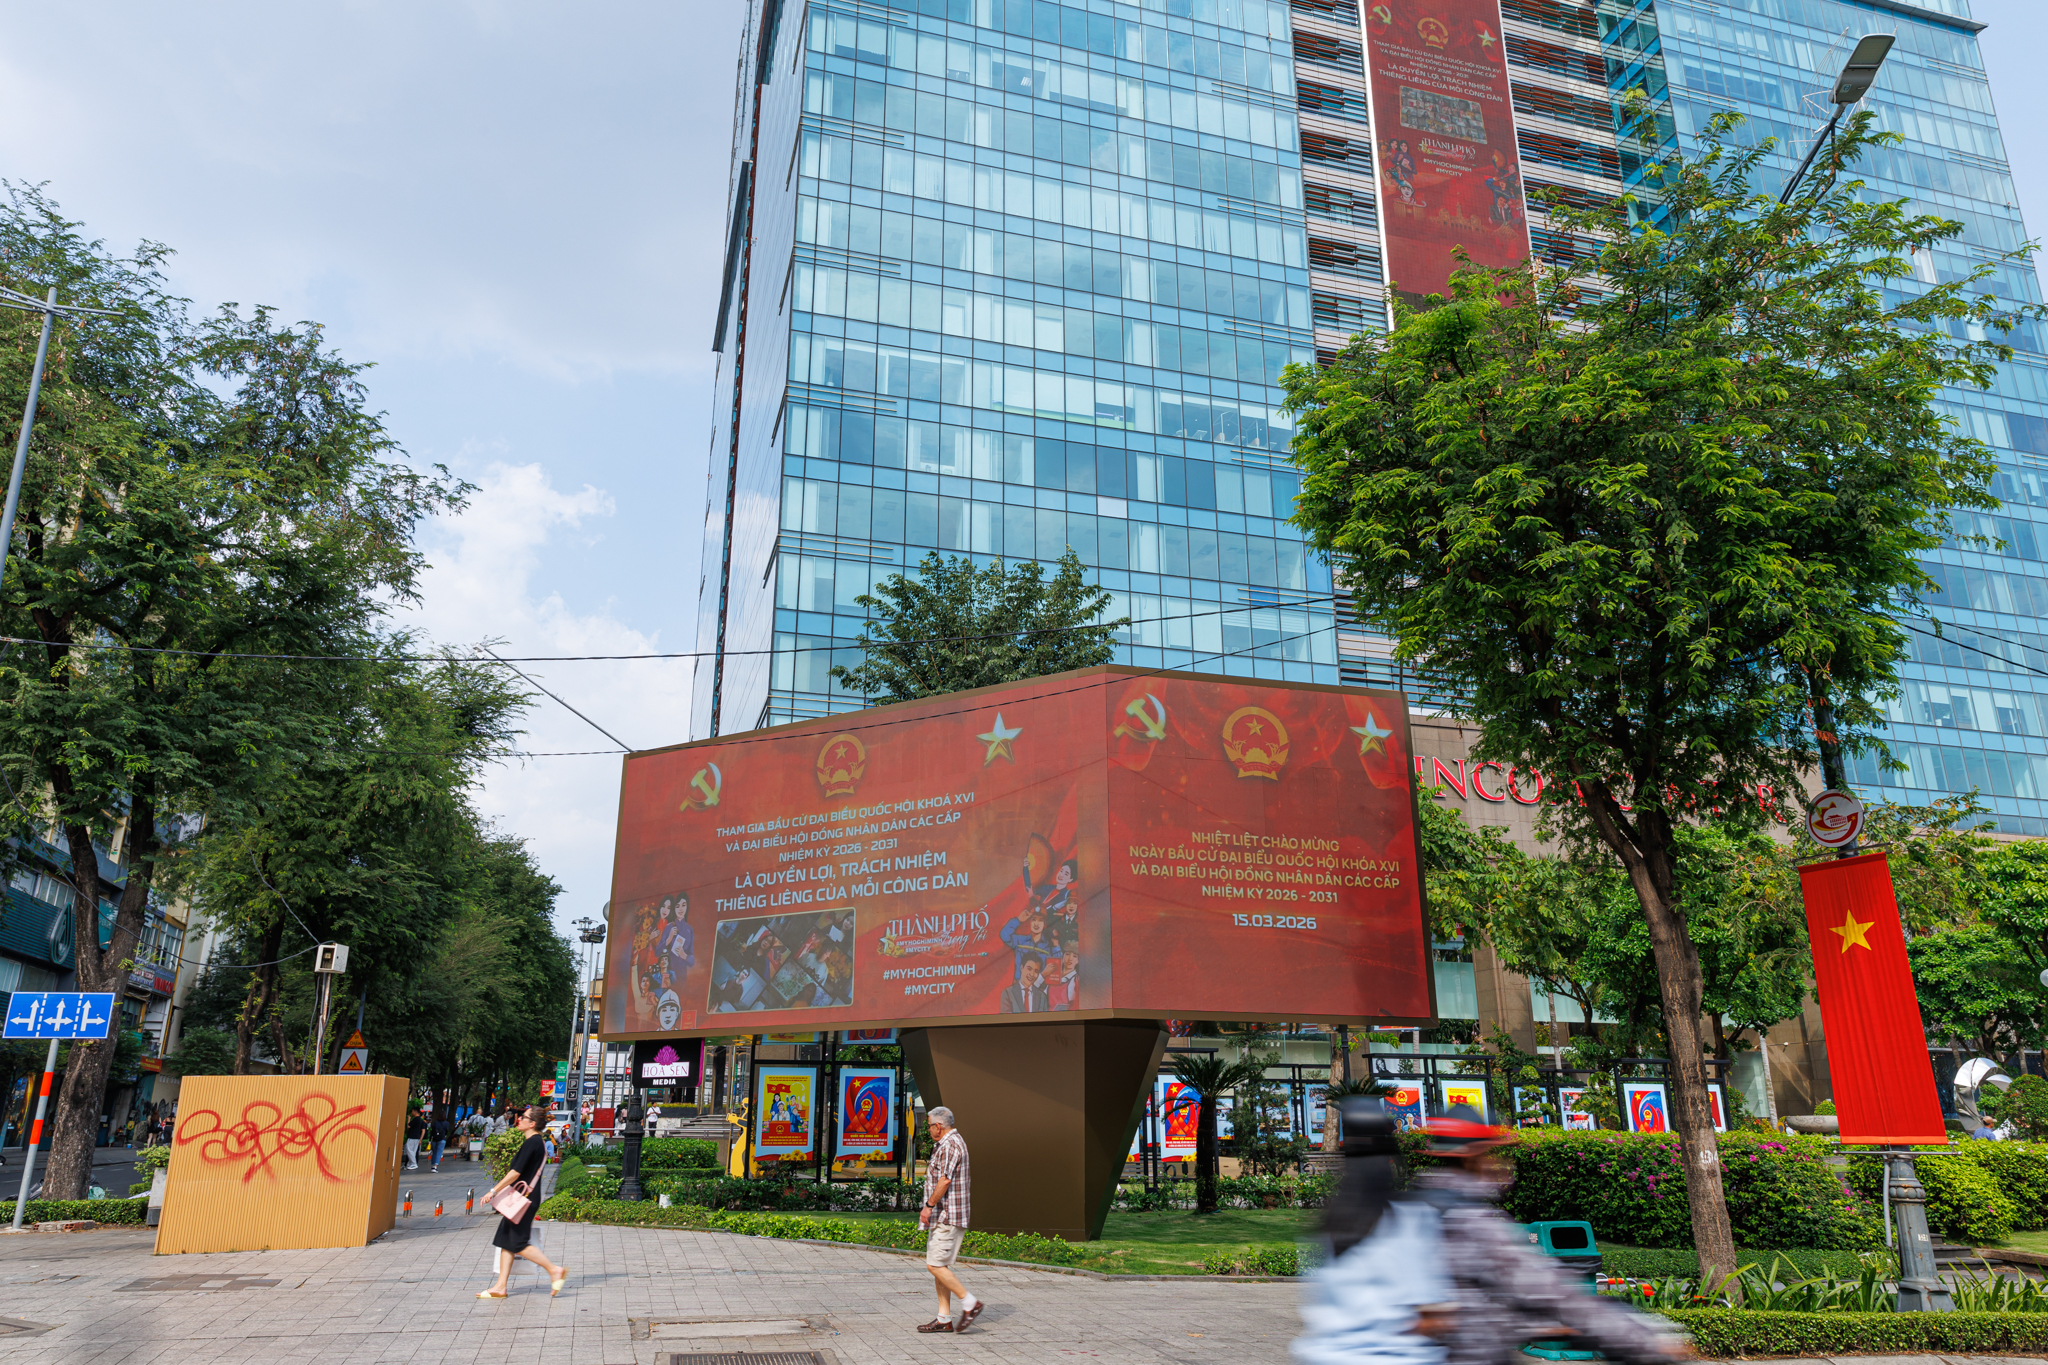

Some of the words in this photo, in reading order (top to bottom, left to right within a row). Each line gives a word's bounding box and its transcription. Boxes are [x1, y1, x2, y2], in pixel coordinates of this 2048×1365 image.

[716, 825, 745, 837] THAM
[747, 822, 765, 834] GIA
[767, 816, 790, 830] BẦU
[792, 813, 807, 827] CỬ
[809, 813, 828, 826] ĐẠI
[830, 806, 856, 822] BIỂU
[859, 801, 892, 818] QUỐC
[894, 799, 915, 813] HỘI
[917, 793, 952, 809] KHOÁ
[954, 792, 974, 805] XVI
[726, 840, 740, 852] VÀ
[742, 839, 760, 852] ĐẠI
[762, 833, 787, 848] BIỂU
[790, 831, 808, 845] HỘI
[811, 827, 843, 842] ĐỒNG
[846, 822, 879, 837] NHÂN
[882, 818, 907, 832] DÂN
[909, 815, 933, 828] CÁC
[936, 809, 961, 825] CẤP
[1192, 830, 1230, 847] NHIỆT
[1233, 832, 1259, 848] LIỆT
[1261, 834, 1298, 850] CHÀO
[1301, 836, 1339, 851] MỪNG
[779, 848, 813, 862] NHIỆM
[816, 845, 830, 858] KỲ
[832, 843, 861, 856] 2026
[871, 838, 897, 851] 2031
[1130, 843, 1165, 858] NGÀY
[1168, 844, 1194, 860] BẦU
[1198, 846, 1218, 861] CỬ
[1220, 851, 1241, 865] ĐẠI
[1244, 849, 1273, 865] BIỂU
[1276, 851, 1314, 867] QUỐC
[1317, 854, 1339, 871] HỘI
[1342, 856, 1377, 871] KHÓA
[1380, 860, 1400, 872] XVI
[735, 872, 752, 888] LÀ
[756, 865, 806, 888] QUYỀN
[810, 864, 836, 882] LỢI,
[840, 857, 891, 876] TRÁCH
[895, 850, 946, 870] NHIỆM
[1131, 860, 1148, 875] VÀ
[1151, 865, 1173, 879] ĐẠI
[1176, 862, 1206, 879] BIỂU
[1209, 865, 1232, 882] HỘI
[1235, 865, 1273, 882] ĐỒNG
[1276, 870, 1312, 884] NHÂN
[1316, 871, 1342, 886] DÂN
[1345, 872, 1371, 887] CÁC
[1374, 873, 1400, 888] CẤP
[715, 894, 767, 912] THIÊNG
[770, 888, 812, 906] LIÊNG
[816, 883, 847, 901] CỦA
[851, 876, 879, 898] MỖI
[883, 876, 928, 894] CÔNG
[932, 870, 968, 889] DÂN
[1202, 883, 1244, 900] NHIỆM
[1247, 884, 1263, 899] KỲ
[1266, 888, 1298, 900] 2026
[1309, 891, 1338, 903] 2031
[889, 914, 947, 936] THÀNH
[952, 904, 989, 931] PHỐ
[1232, 914, 1317, 929] 15.03.2026
[883, 964, 975, 980] #MYHOCHIMINH
[904, 983, 955, 995] #MYCITY
[643, 1066, 665, 1076] HOA
[670, 1065, 688, 1075] SEN
